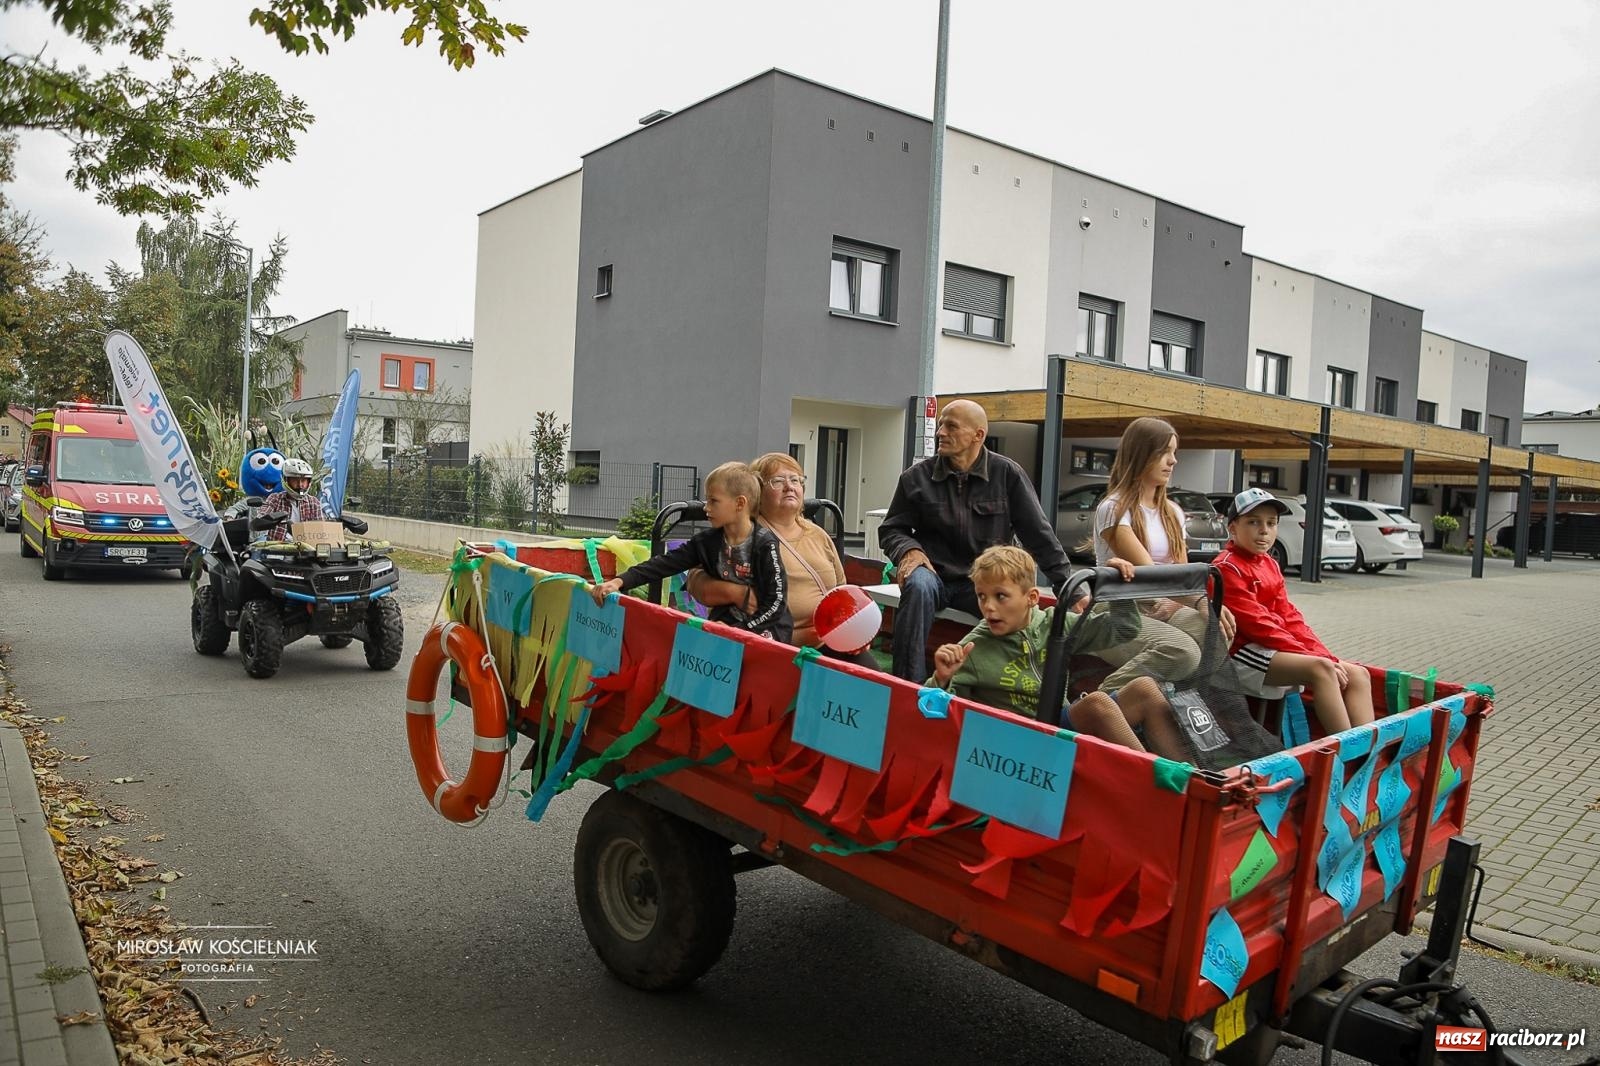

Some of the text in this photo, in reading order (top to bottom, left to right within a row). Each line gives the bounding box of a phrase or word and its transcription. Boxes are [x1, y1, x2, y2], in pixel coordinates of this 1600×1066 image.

[809, 430, 814, 440] 7
[503, 589, 514, 605] W
[678, 650, 733, 684] WSKOCZ
[821, 700, 859, 729] JAK
[966, 747, 1059, 792] ANIOŁEK
